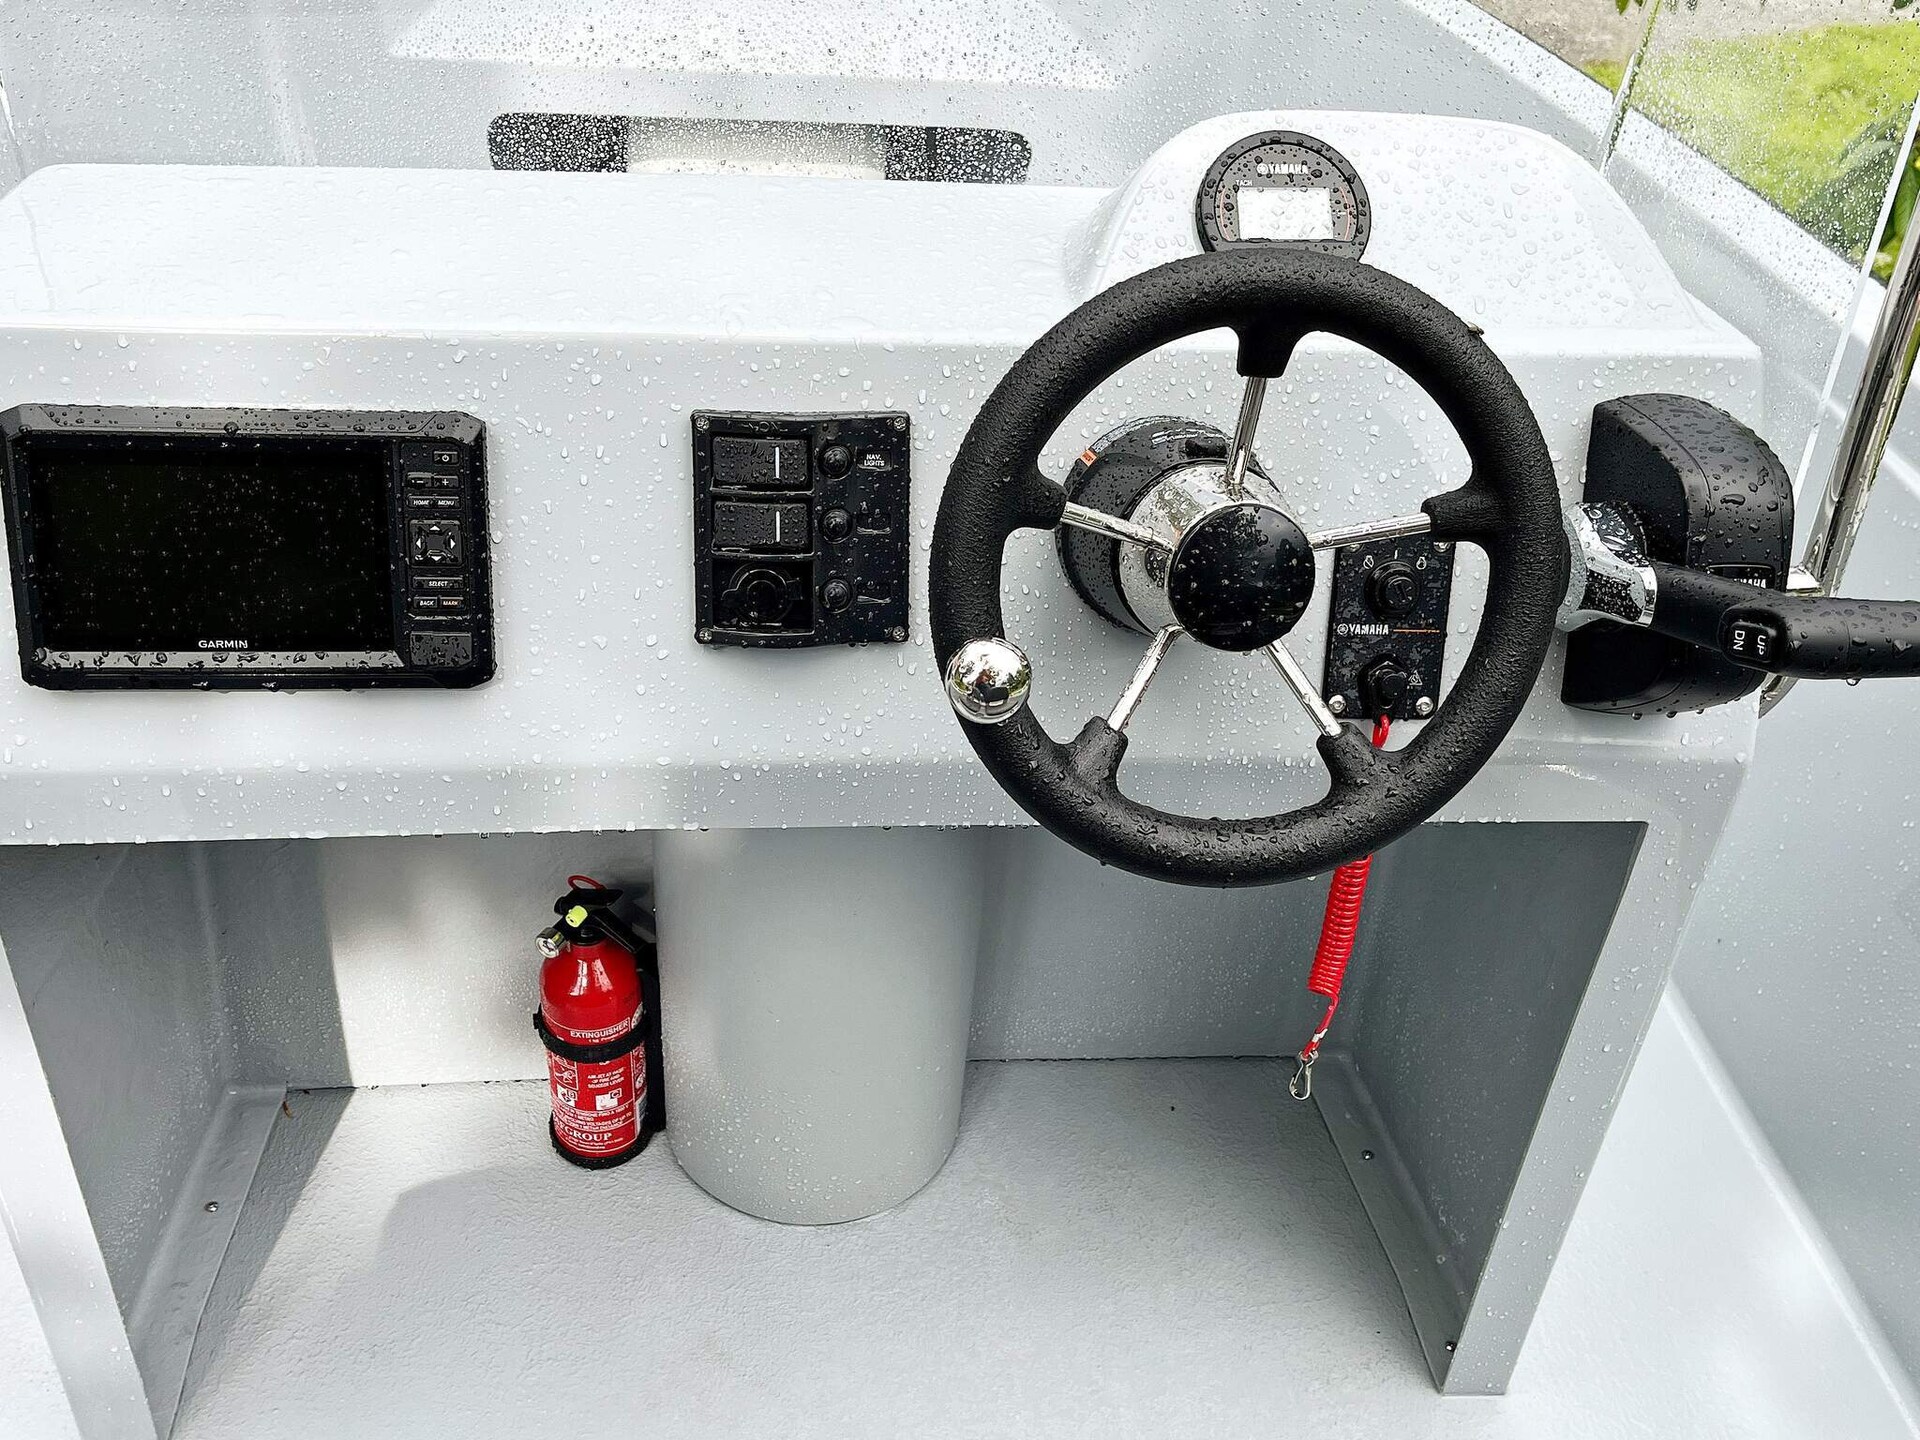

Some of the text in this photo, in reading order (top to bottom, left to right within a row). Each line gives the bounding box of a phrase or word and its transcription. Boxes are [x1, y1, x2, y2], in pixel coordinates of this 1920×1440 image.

[1268, 163, 1309, 175] YAMAHA
[1235, 179, 1253, 187] TACH
[1349, 623, 1389, 636] YAMAHA
[198, 639, 249, 649] GARMIN
[1733, 630, 1746, 650] DN
[1757, 634, 1767, 656] UP
[570, 1020, 629, 1039] EXTINGUISHER
[564, 1126, 613, 1141] GROUP
